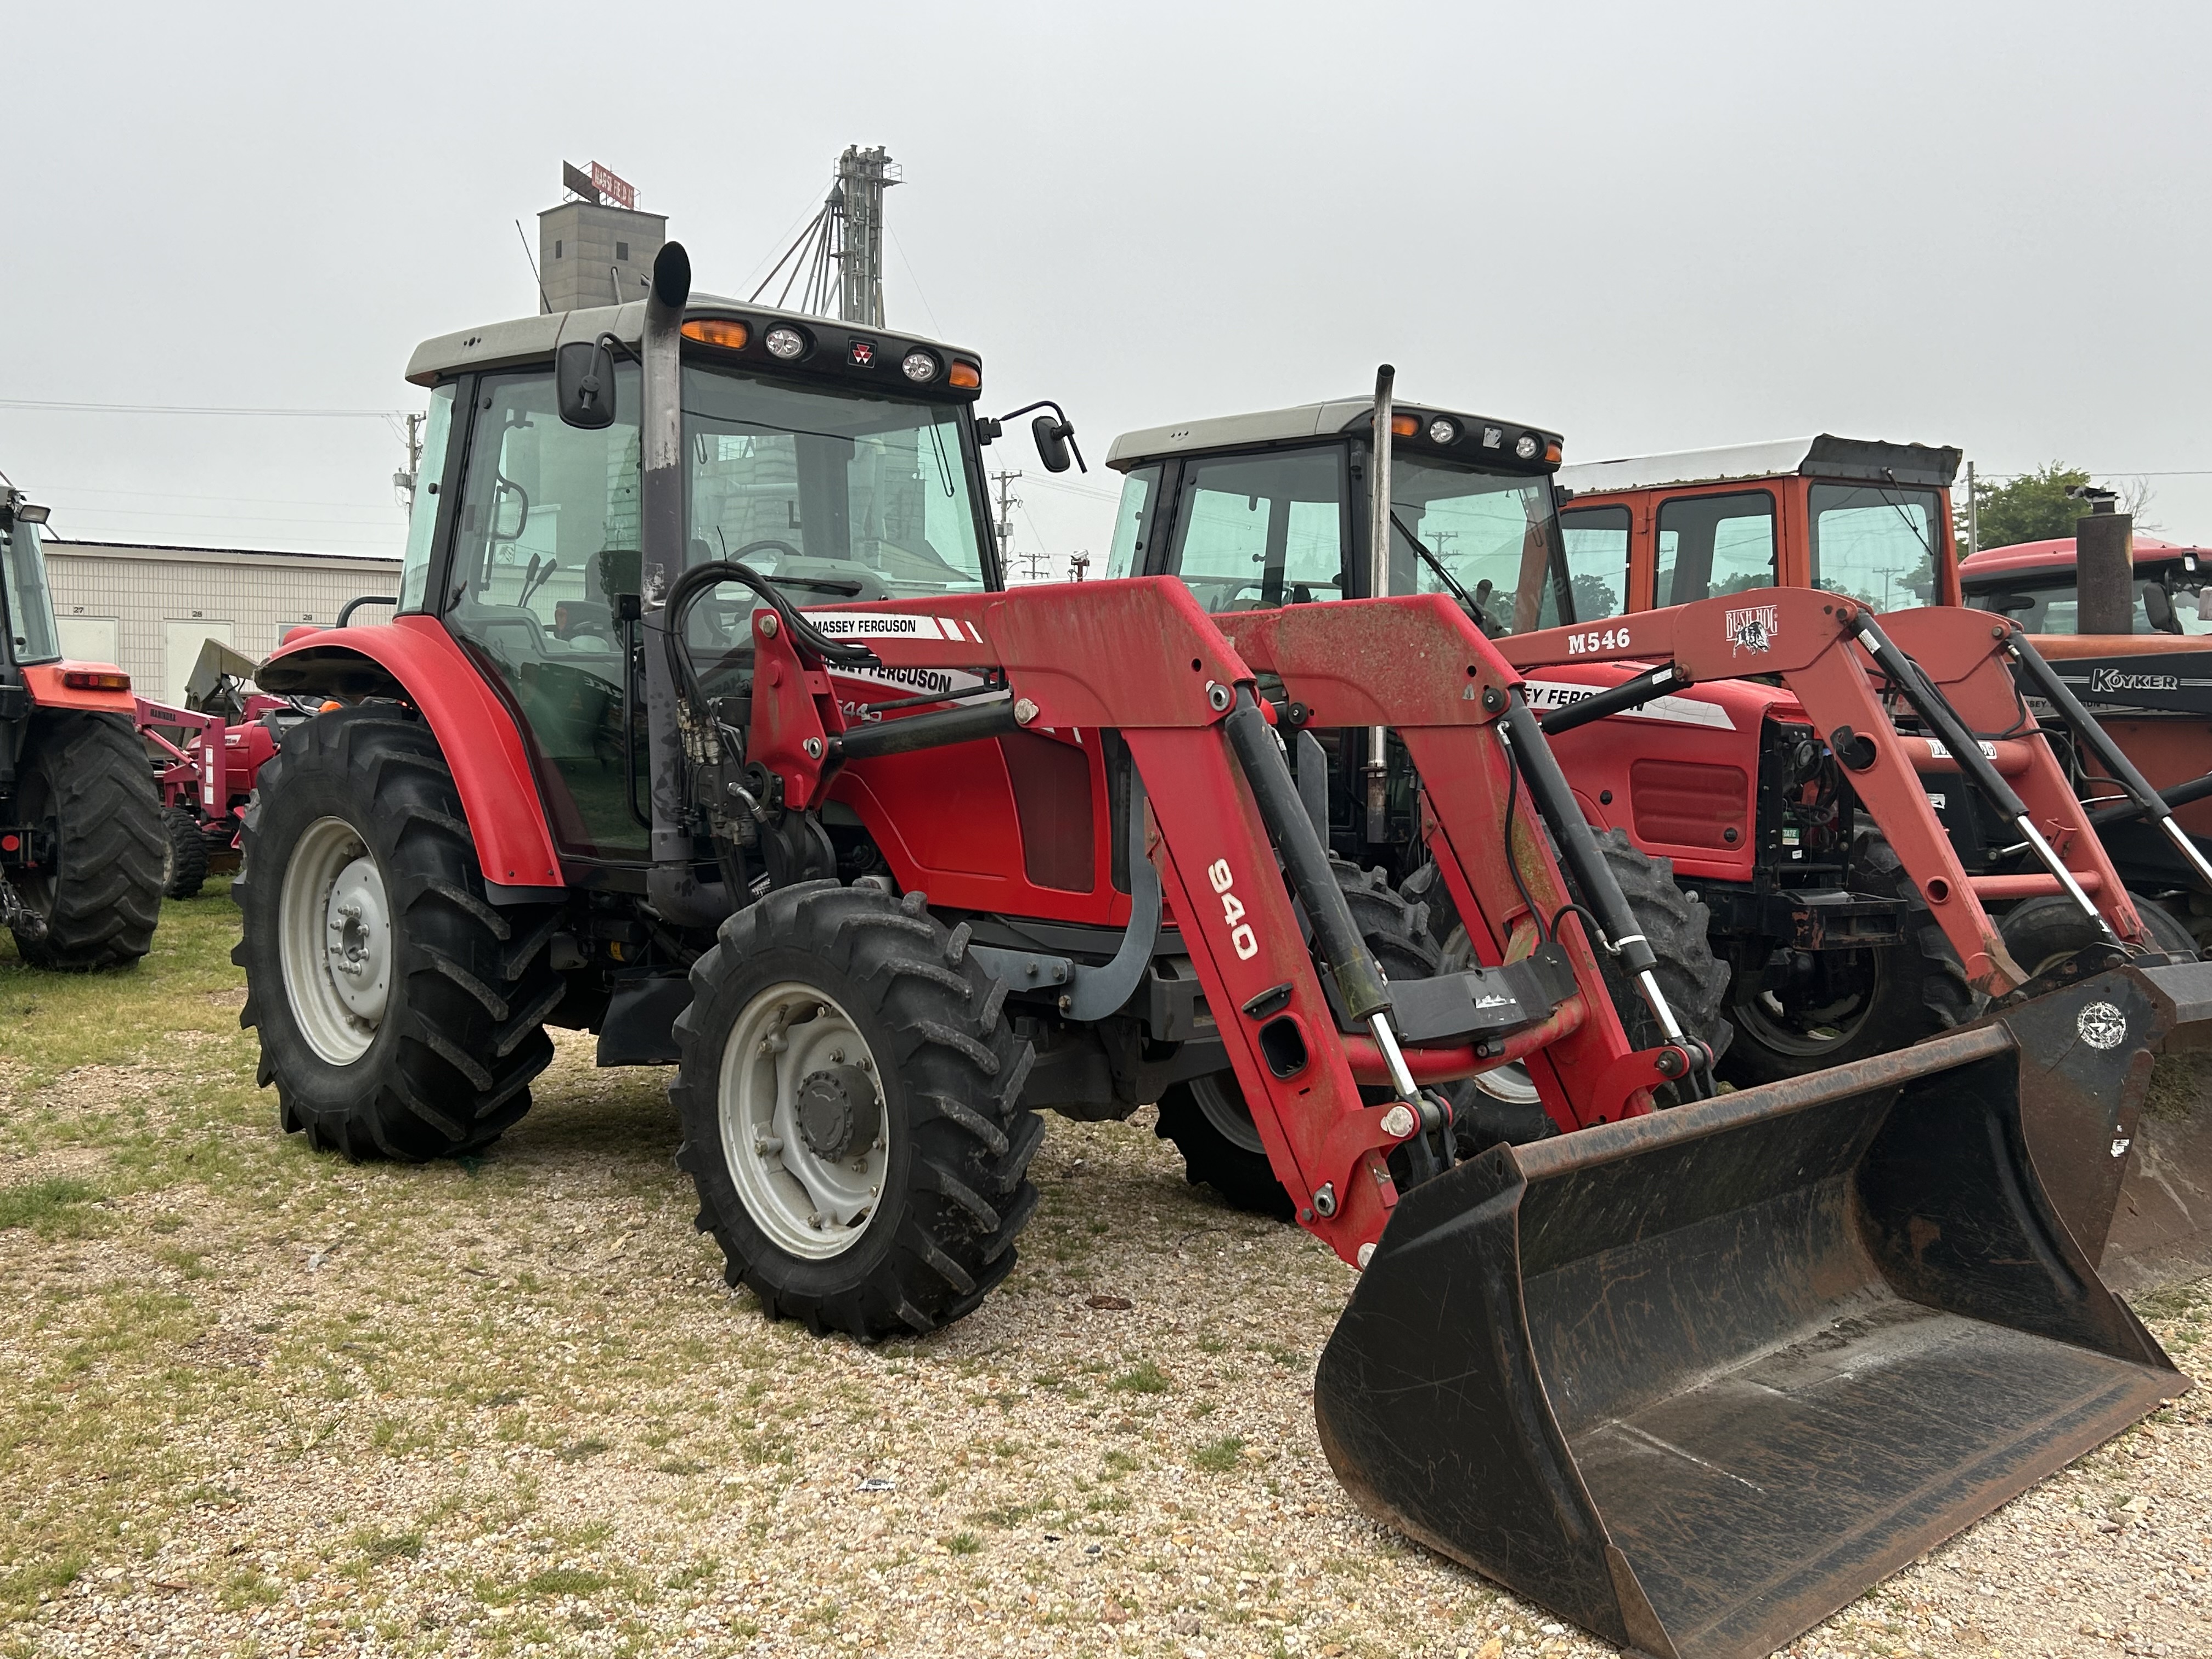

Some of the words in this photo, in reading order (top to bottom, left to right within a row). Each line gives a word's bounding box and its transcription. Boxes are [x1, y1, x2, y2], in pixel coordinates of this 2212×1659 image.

[813, 620, 855, 633] MASSEY
[858, 619, 916, 633] FERGUSON
[1726, 611, 1752, 639] BUSH
[1756, 607, 1777, 633] HOG
[1568, 628, 1630, 655] M546
[1208, 858, 1259, 961] 940
